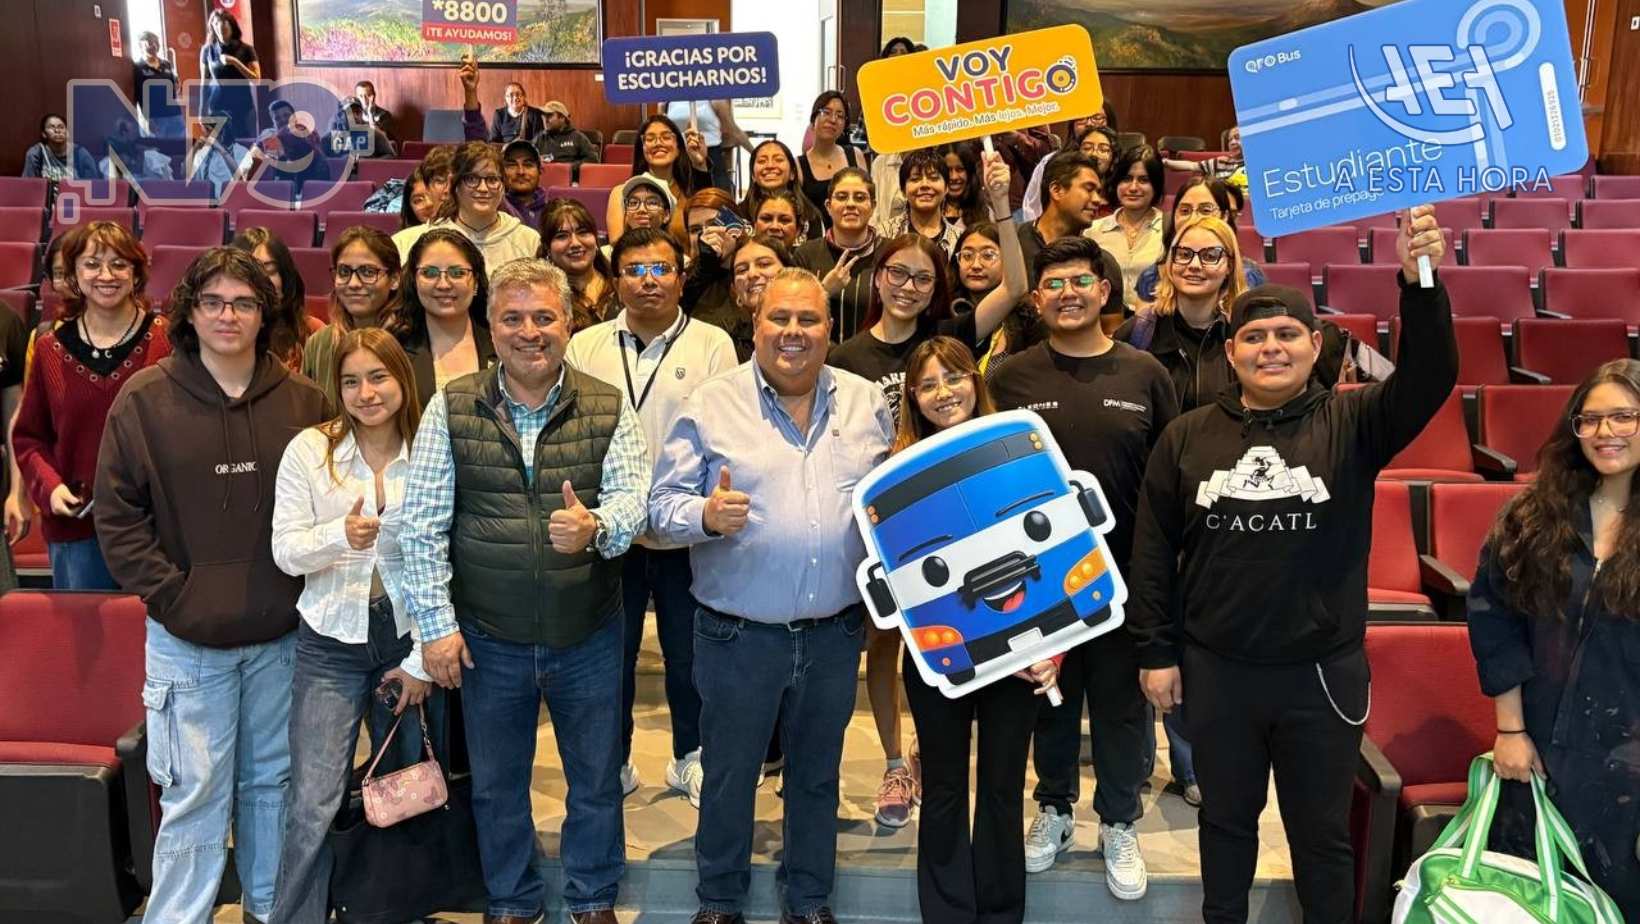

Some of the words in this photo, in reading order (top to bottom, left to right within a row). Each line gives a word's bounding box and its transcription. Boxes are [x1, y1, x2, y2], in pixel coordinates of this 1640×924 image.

[445, 28, 512, 41] AYUDAMOS!
[624, 49, 712, 68] ¡GRACIAS
[717, 46, 757, 63] POR
[936, 46, 1012, 81] VOY
[1277, 50, 1301, 64] Bus
[617, 67, 767, 90] ESCUCHARNOS!
[883, 60, 1077, 125] CONTIGO
[975, 113, 997, 126] Más
[1263, 138, 1443, 199] Estudiante
[1271, 201, 1313, 220] Tarjeta
[1314, 198, 1331, 210] de
